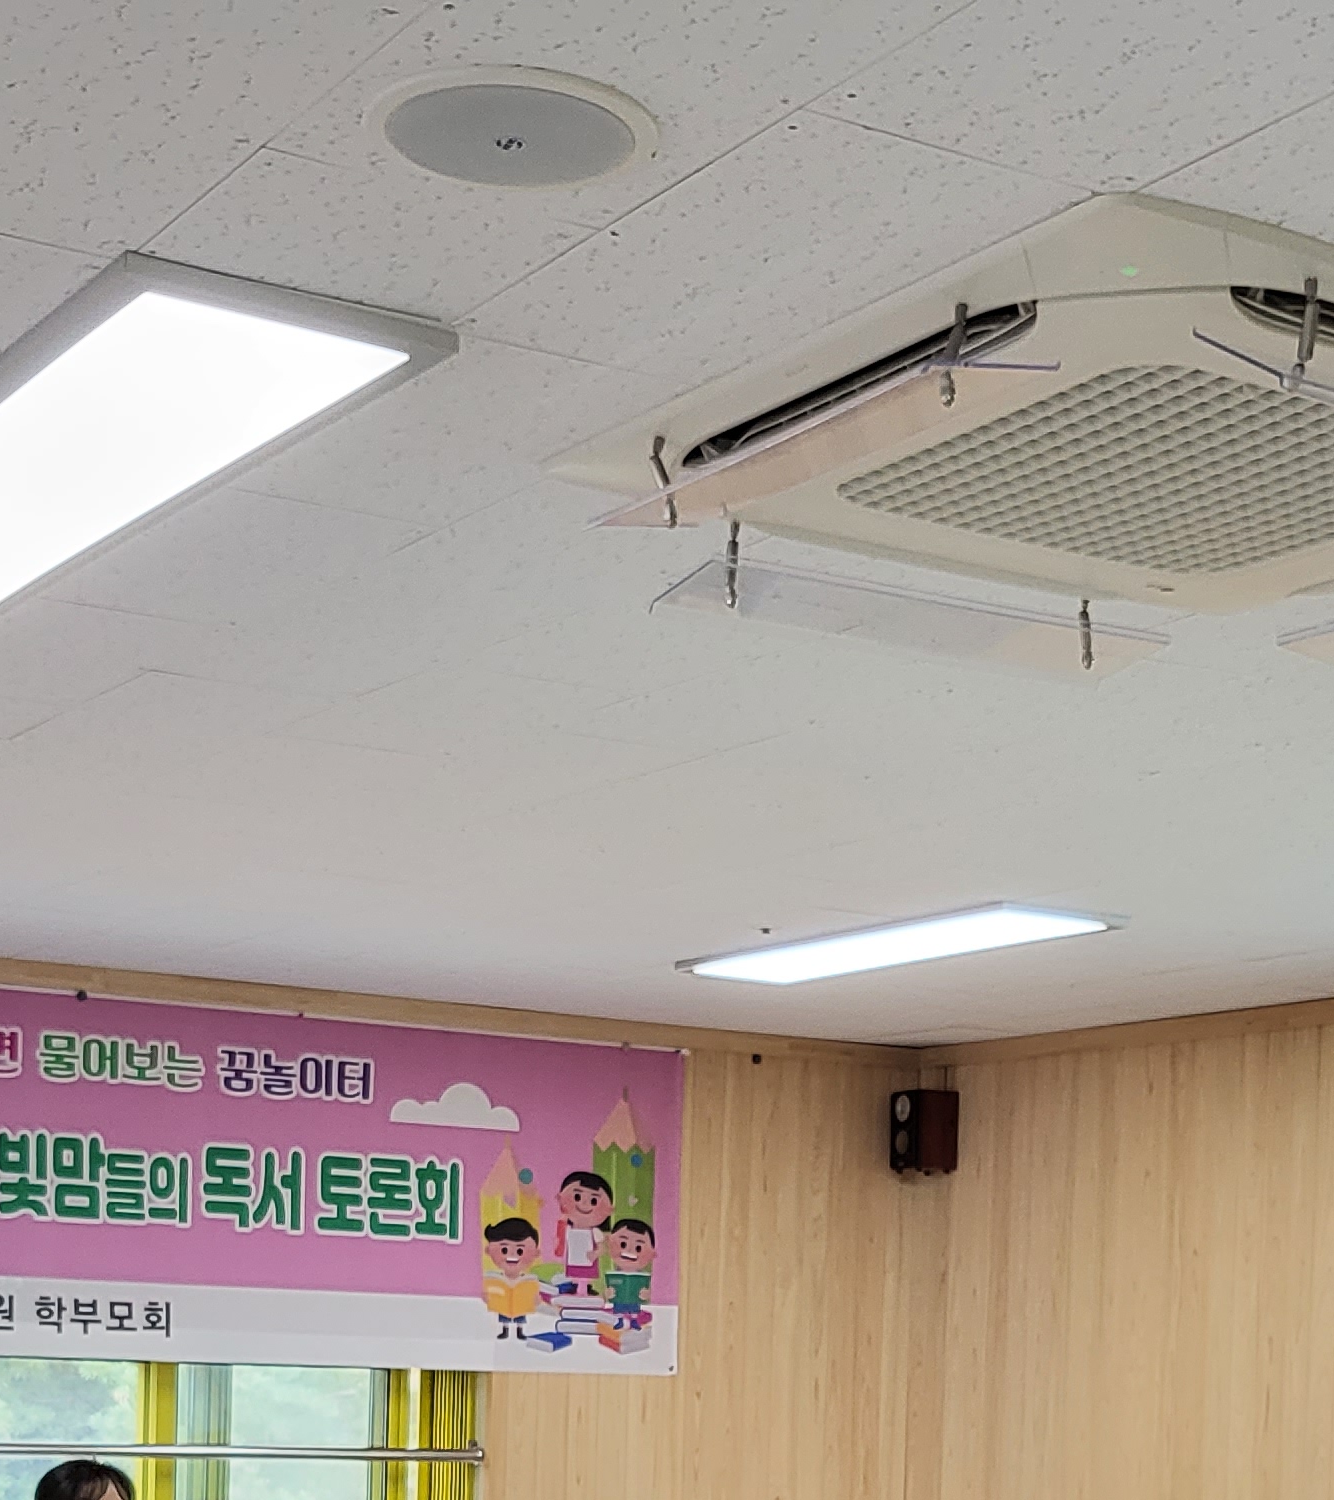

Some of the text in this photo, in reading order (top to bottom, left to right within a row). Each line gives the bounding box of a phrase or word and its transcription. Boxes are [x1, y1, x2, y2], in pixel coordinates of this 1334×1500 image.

[39, 1032, 202, 1089] 물어보는
[219, 1047, 372, 1102] 꿈놀이터
[202, 1145, 303, 1231] 독서
[316, 1159, 460, 1240] 토론회
[33, 1295, 173, 1338] 학부모회
